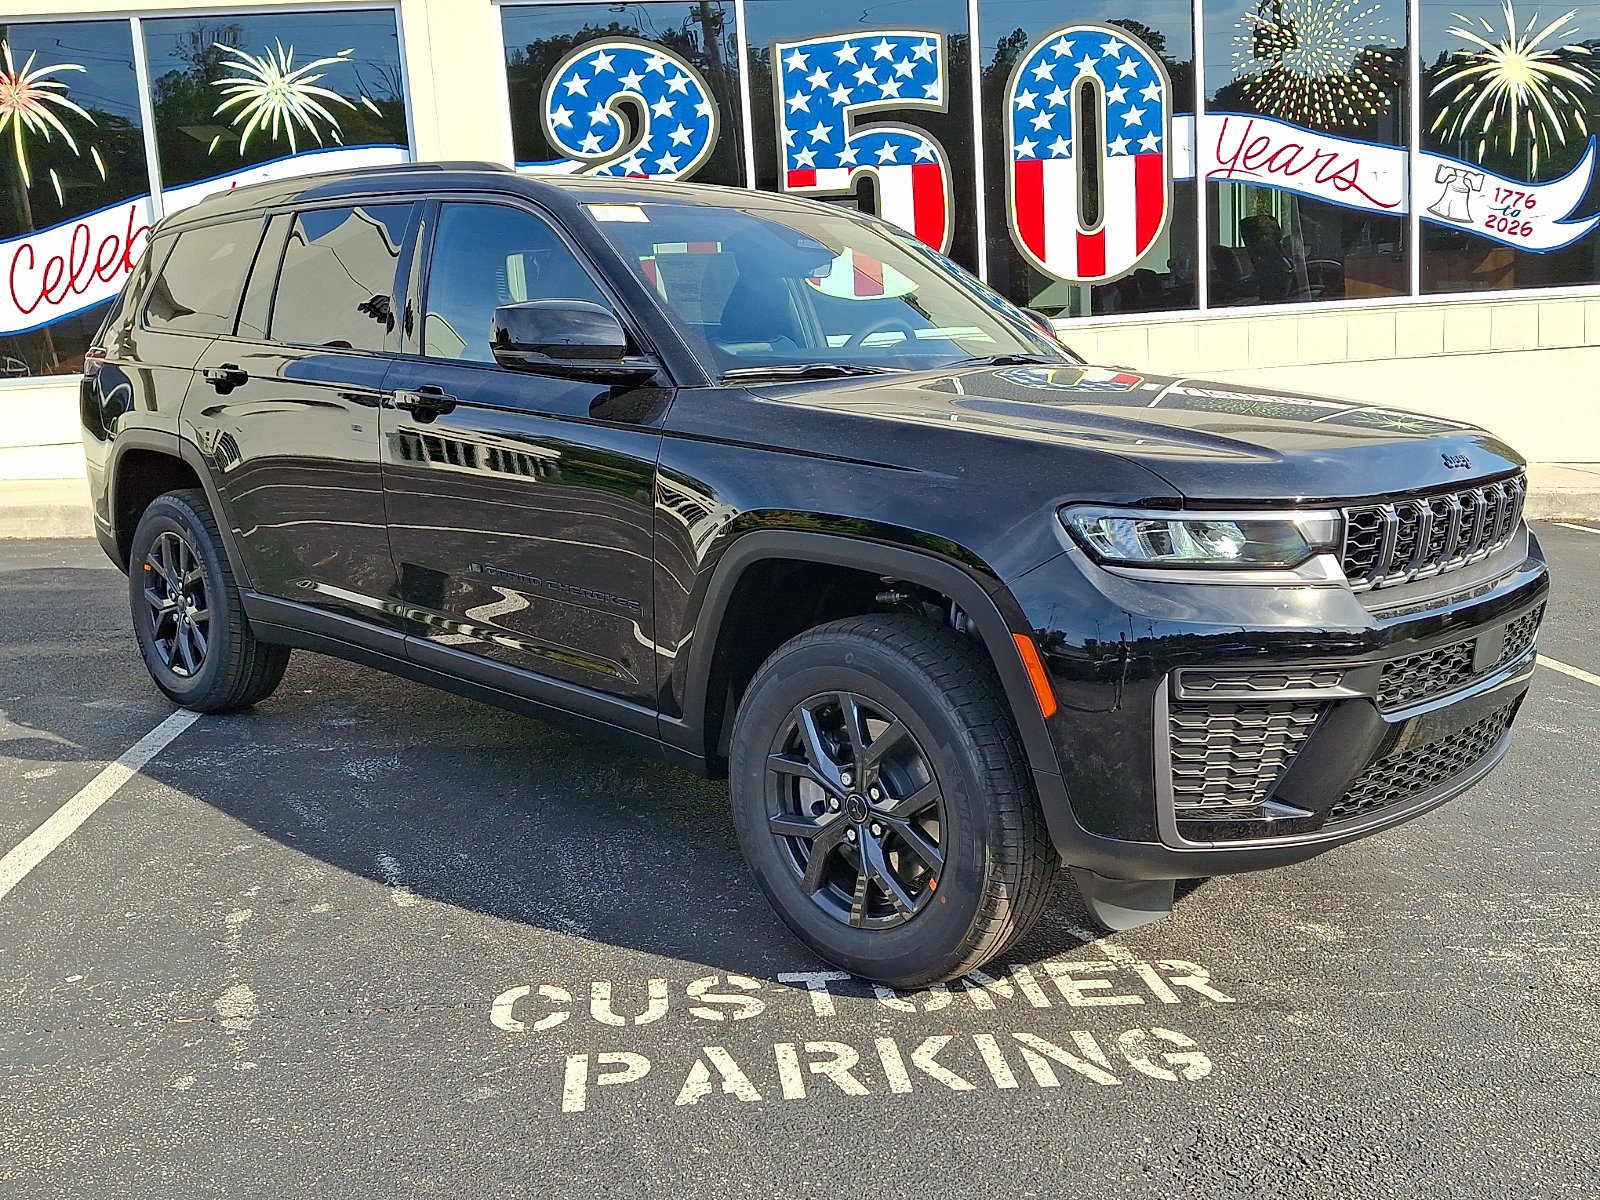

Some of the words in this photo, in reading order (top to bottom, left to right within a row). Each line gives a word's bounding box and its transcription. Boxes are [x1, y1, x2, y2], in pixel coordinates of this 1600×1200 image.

[10, 205, 152, 314] Celeb
[539, 23, 1173, 299] 250
[1206, 117, 1402, 208] Years
[1495, 187, 1537, 209] 1776
[1488, 205, 1521, 217] to
[1485, 214, 1533, 237] 2026
[1441, 453, 1472, 470] Jeep
[562, 1026, 1213, 1113] PARKING
